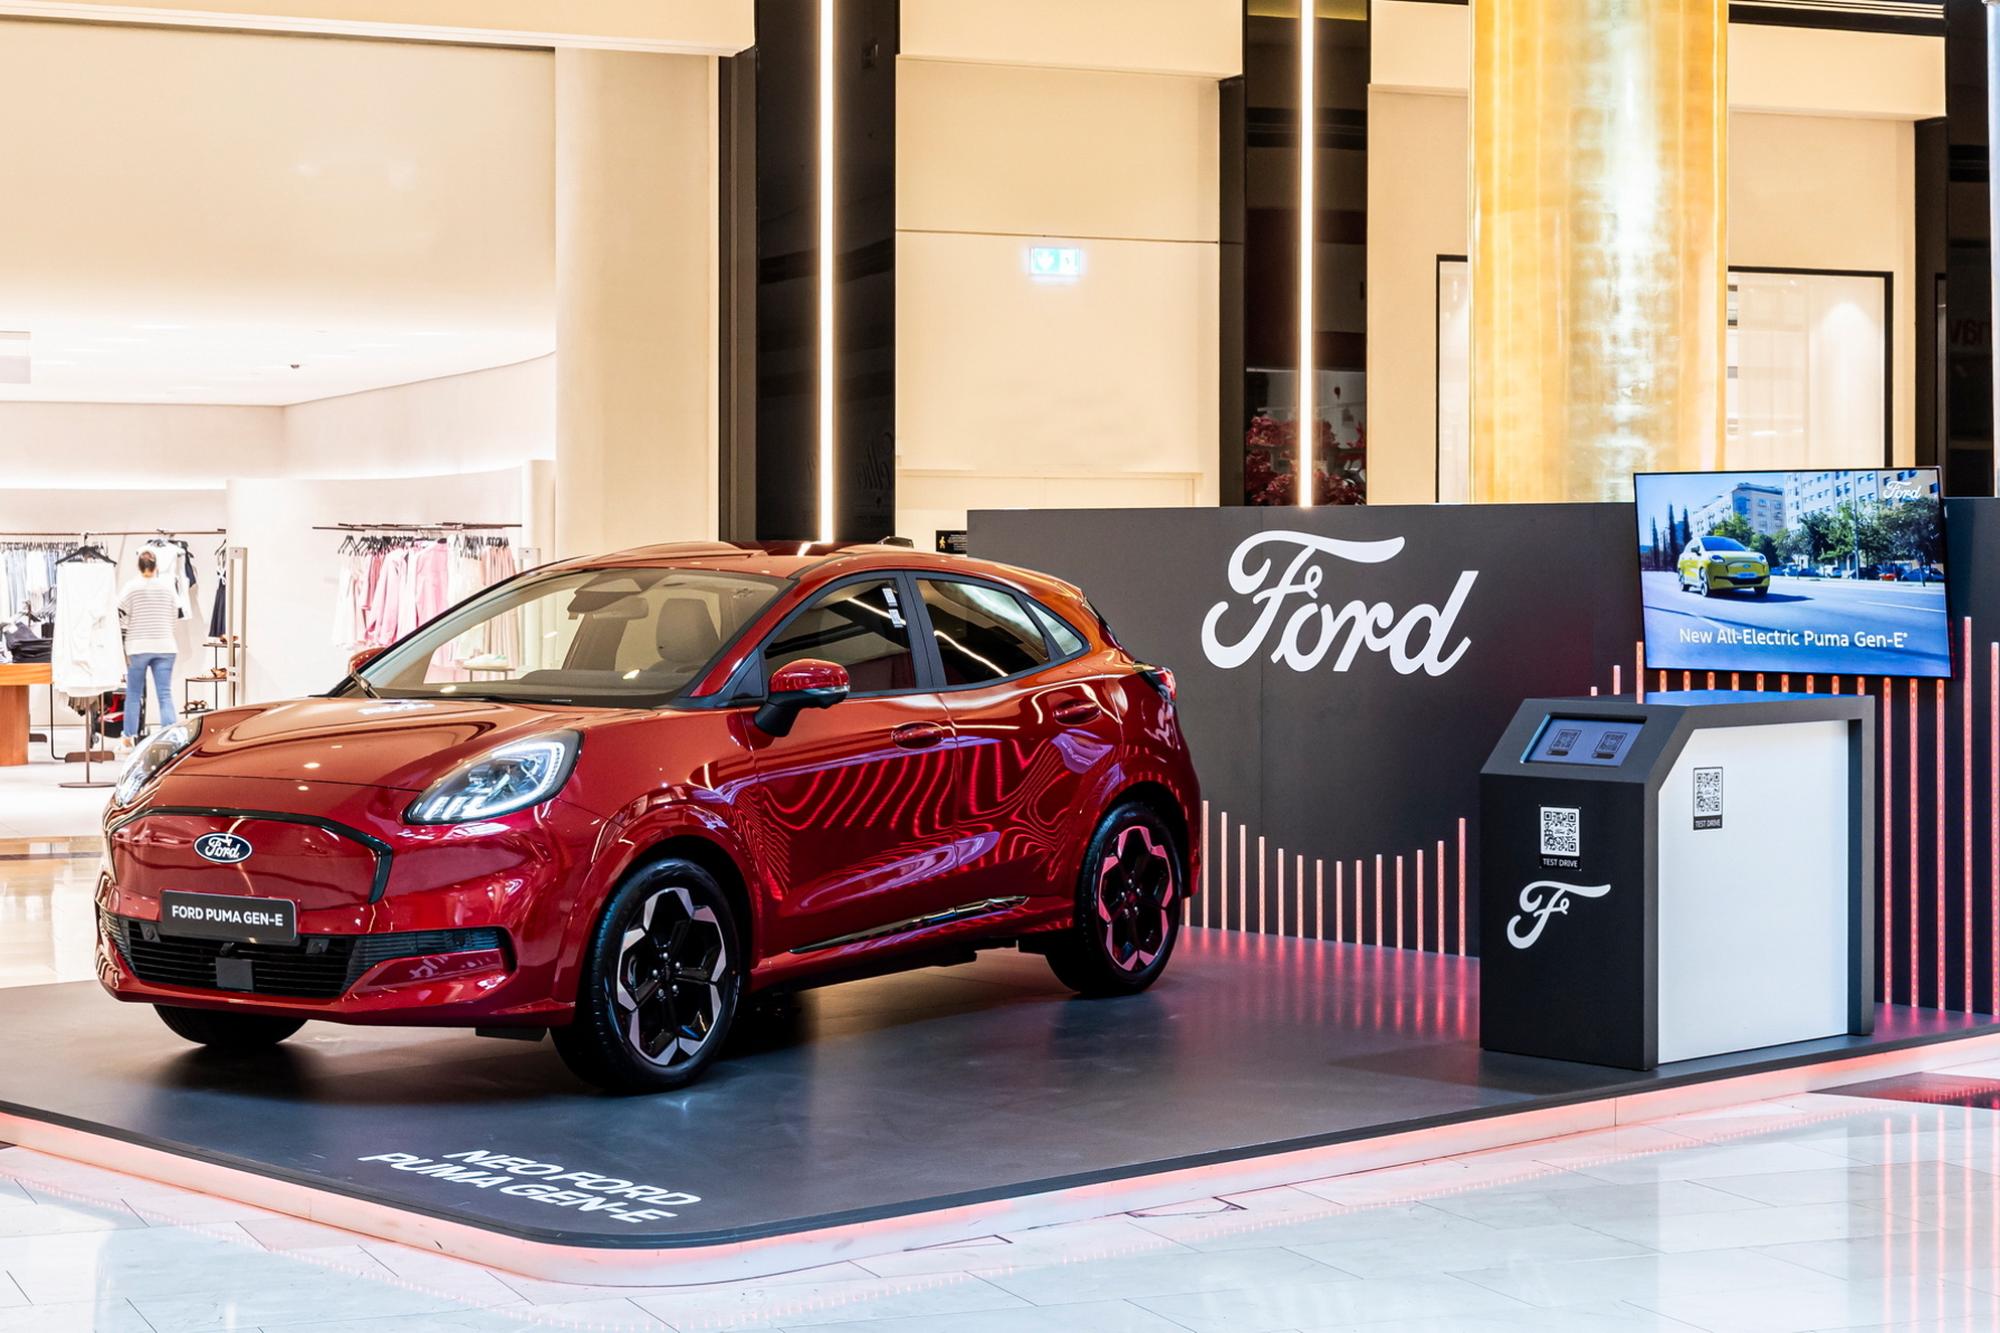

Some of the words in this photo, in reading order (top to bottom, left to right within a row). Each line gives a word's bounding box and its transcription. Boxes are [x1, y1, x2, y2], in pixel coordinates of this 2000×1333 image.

[1883, 481, 1921, 499] Ford
[1201, 530, 1479, 677] Ford
[1680, 628, 1712, 643] New
[1716, 627, 1799, 646] All-Electric
[1804, 631, 1849, 647] Puma
[204, 837, 240, 858] Ford
[1543, 858, 1558, 866] TEST
[1559, 859, 1578, 868] DRIVE
[172, 905, 204, 919] FORD
[206, 909, 242, 923] PUMA
[243, 912, 283, 926] GEN-E
[358, 1152, 514, 1189] PUMA
[500, 1184, 678, 1223] GEN-E
[442, 1150, 564, 1176] NEO
[542, 1171, 702, 1206] FORD
